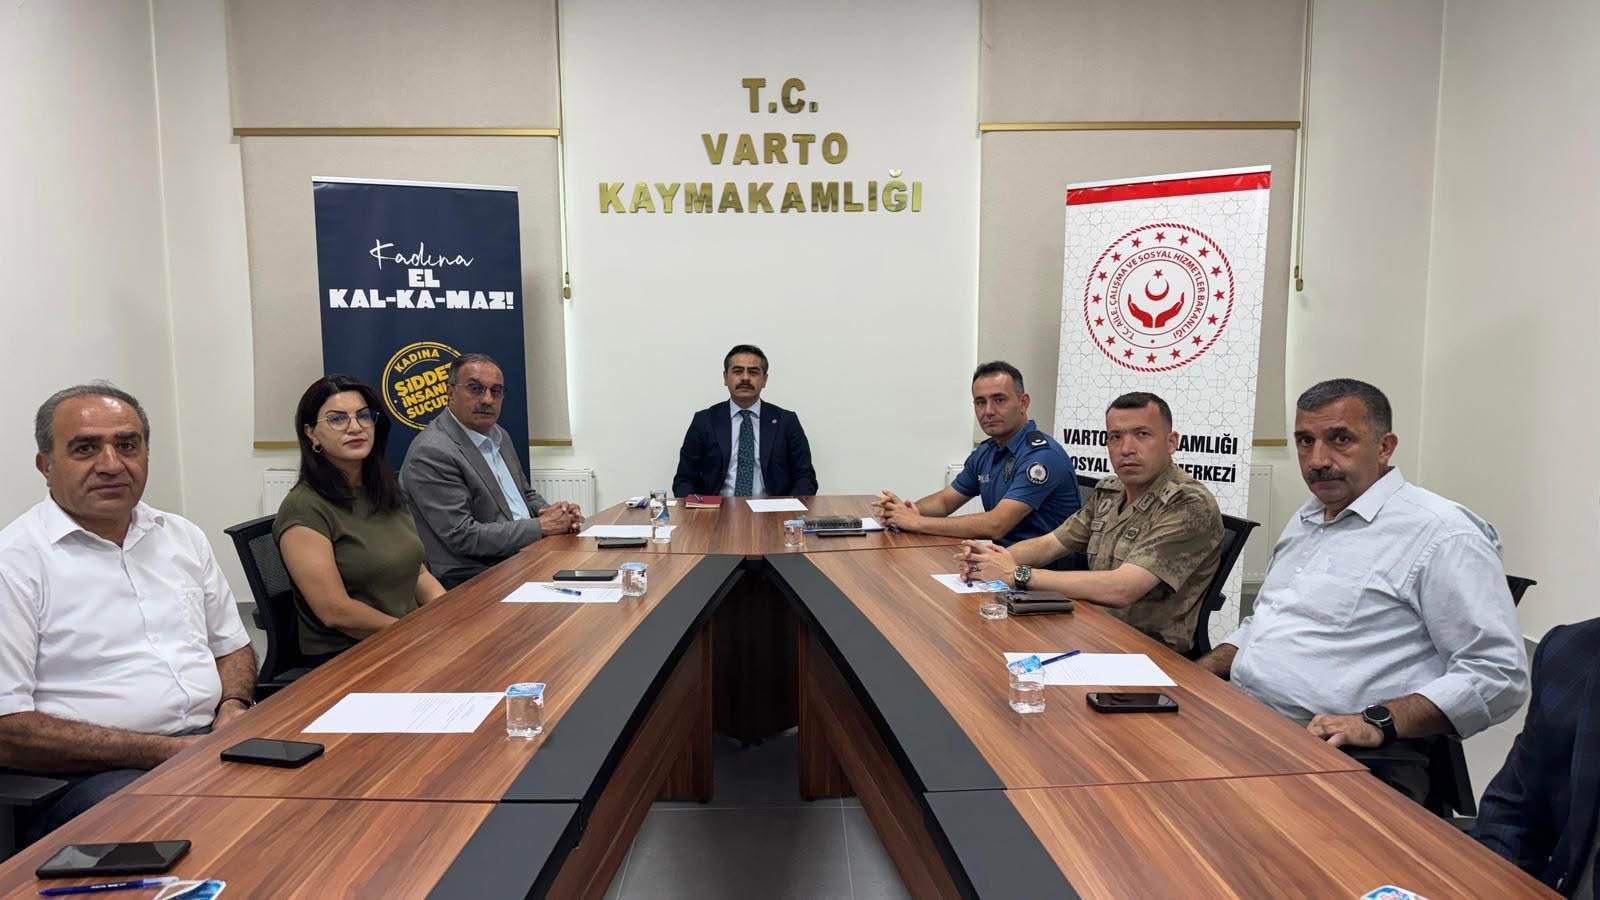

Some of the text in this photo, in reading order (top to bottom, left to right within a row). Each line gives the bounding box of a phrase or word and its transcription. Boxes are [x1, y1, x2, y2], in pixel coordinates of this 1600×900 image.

[742, 77, 819, 113] T.C.
[701, 132, 849, 165] VARTO
[598, 168, 923, 213] KAYMAKAMLIĞI
[369, 238, 474, 270] Kadına
[1125, 257, 1139, 269] VE
[1138, 250, 1172, 262] SOSYAL
[408, 268, 441, 288] EL
[1173, 252, 1206, 294] HİZMETLER
[328, 288, 515, 310] KAL-KA-MAZ!
[1109, 267, 1128, 307] ÇALIŞMA
[1172, 294, 1206, 339] BAKANLIĞI
[394, 348, 440, 374] KADINA
[401, 381, 448, 408] İNSAN
[406, 394, 449, 419] SUÇUD
[1063, 428, 1238, 455] VARTO AMLIĞI
[1070, 455, 1110, 473] OSYAL
